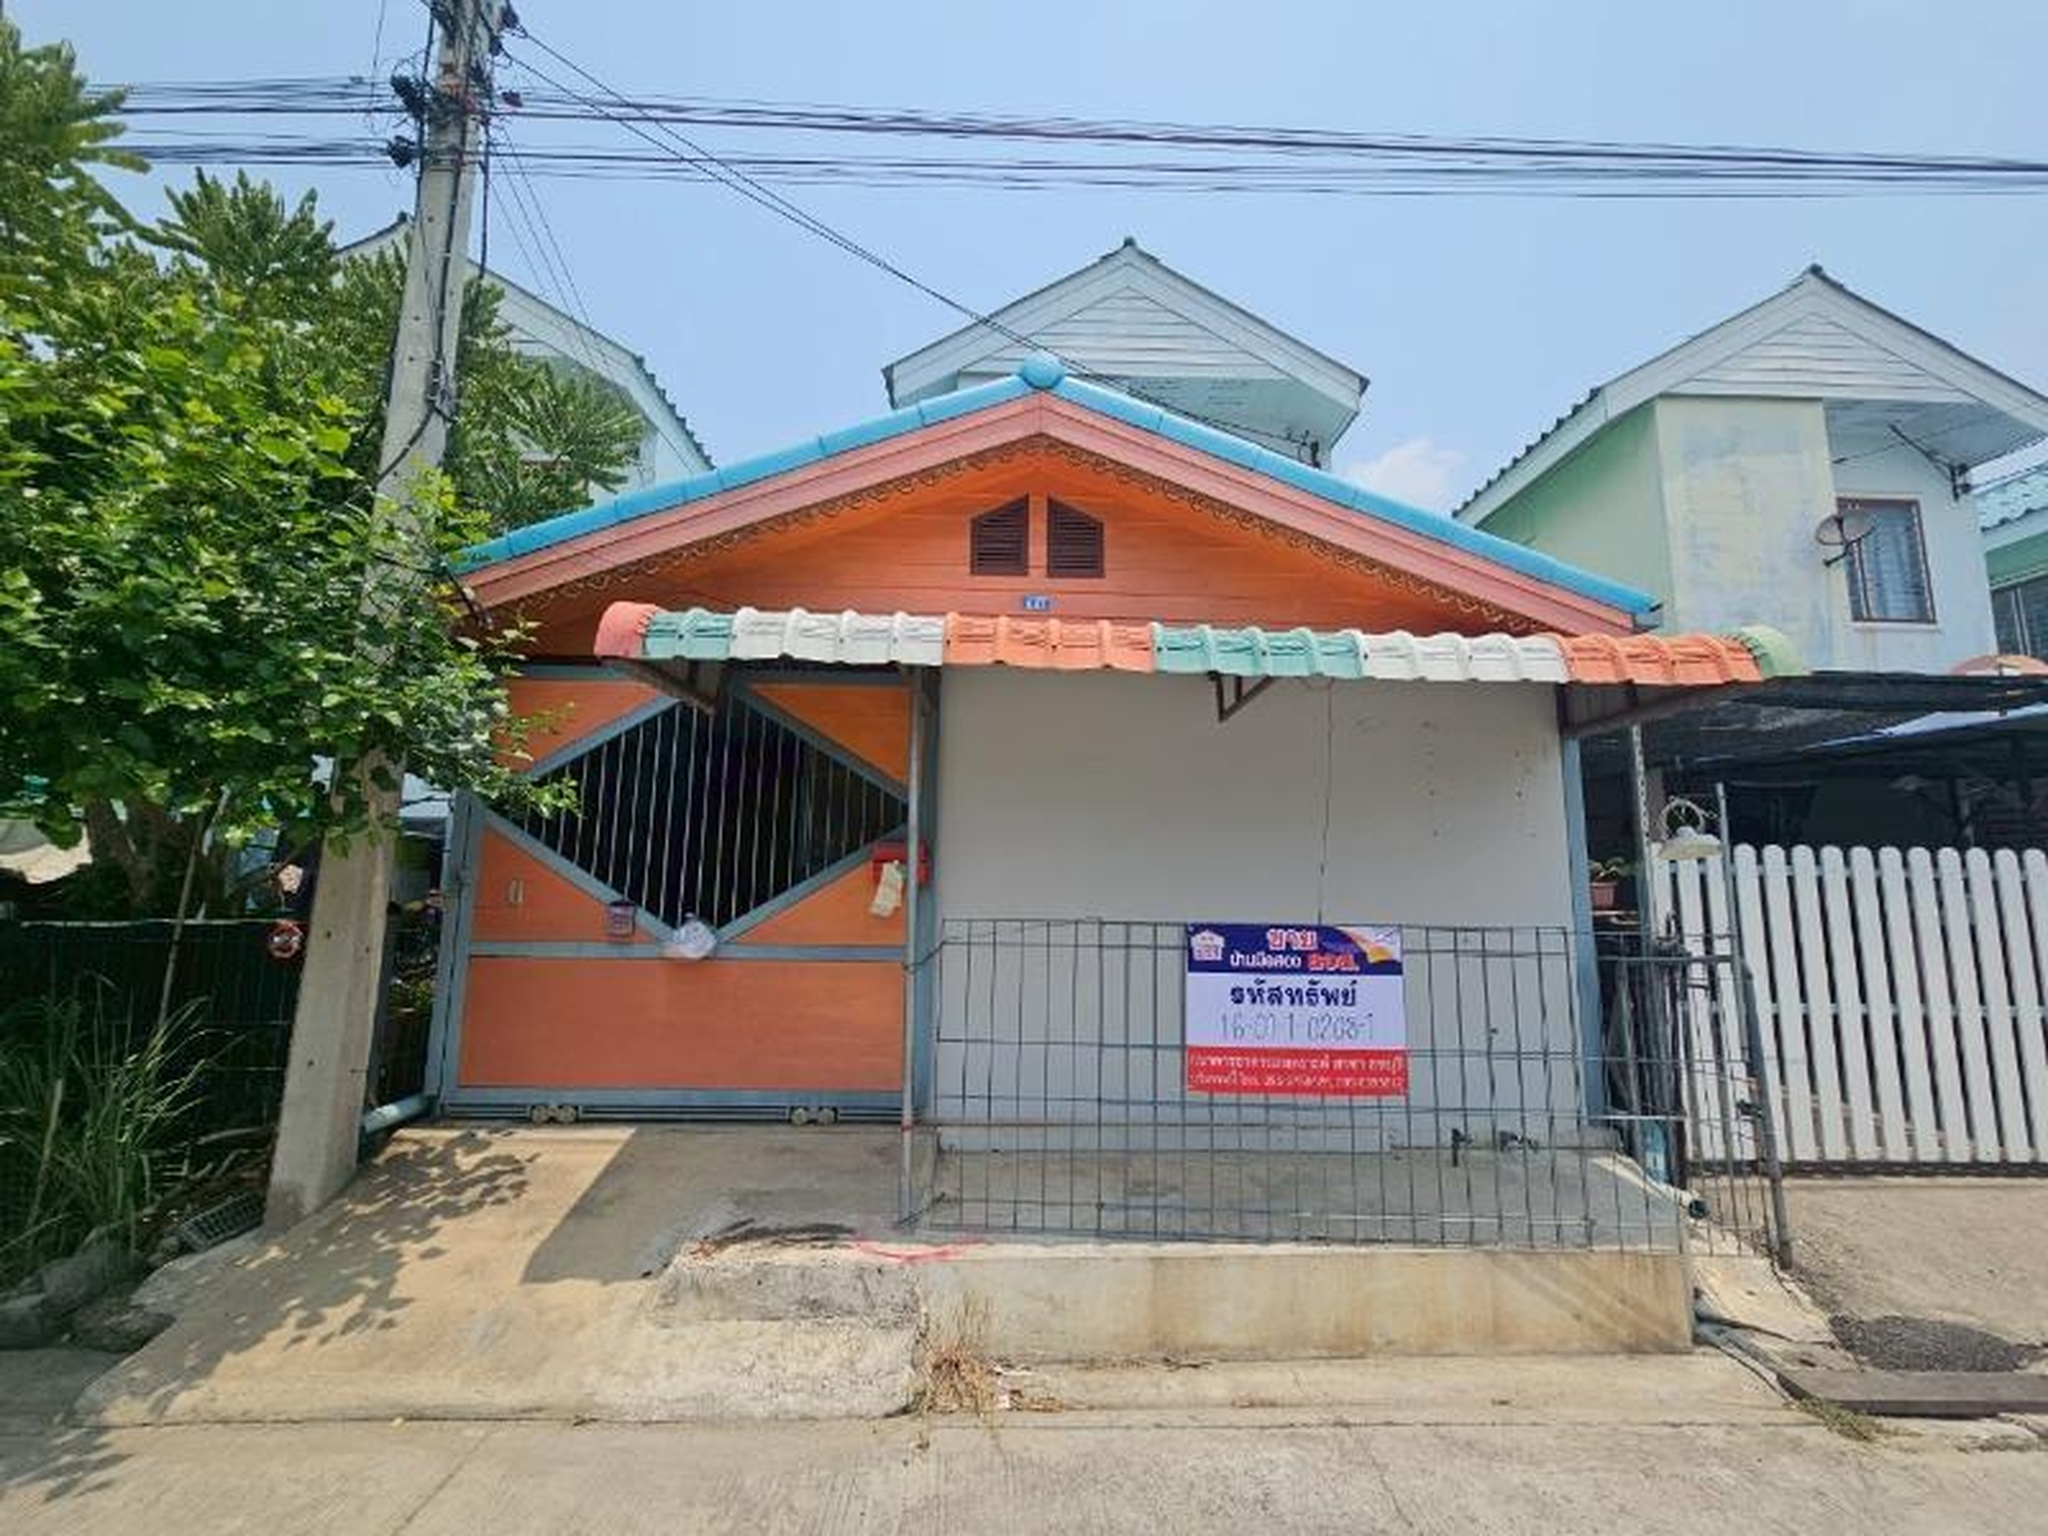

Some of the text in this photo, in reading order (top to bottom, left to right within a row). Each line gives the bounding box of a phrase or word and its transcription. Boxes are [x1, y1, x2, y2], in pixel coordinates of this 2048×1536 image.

[1266, 928, 1318, 950] ขาย
[1230, 949, 1301, 968] บ้านมือสอง
[1230, 978, 1358, 1007] รหัสทรัพย์
